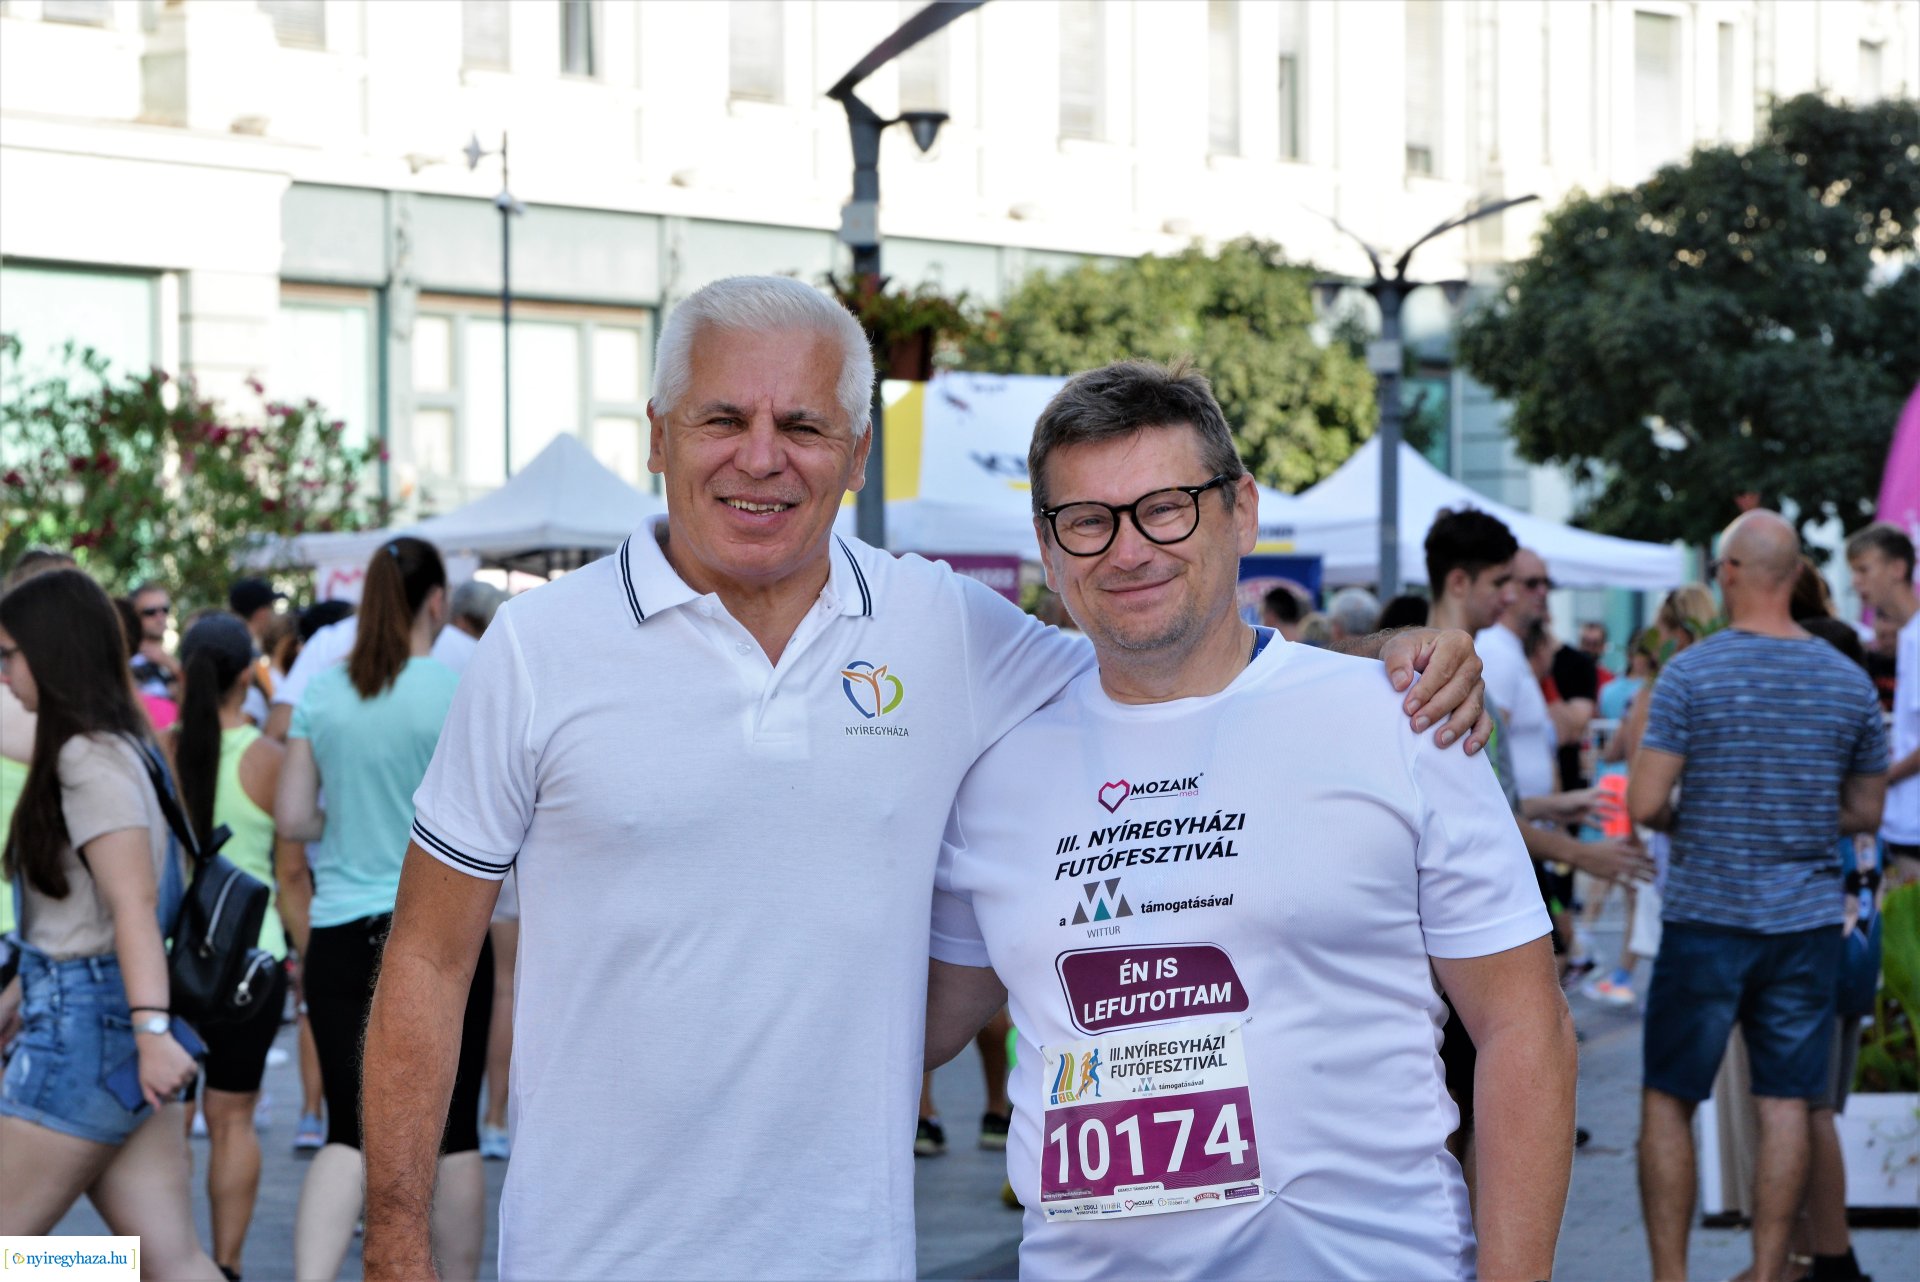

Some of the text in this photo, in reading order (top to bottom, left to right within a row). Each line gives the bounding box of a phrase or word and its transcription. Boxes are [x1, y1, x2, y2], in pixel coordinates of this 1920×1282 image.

[845, 724, 909, 736] NYÍREGYHÁZA
[1130, 776, 1199, 795] MOZAIK
[1179, 789, 1199, 797] med
[1056, 809, 1246, 855] III. NYÍREGYHÁZI
[1055, 835, 1239, 880] FUTÓFESZTIVÁL
[1059, 893, 1234, 926] a támogatásával
[1086, 925, 1121, 938] WITTUR
[1119, 957, 1178, 985] ÉN IS
[1083, 982, 1232, 1024] LEFUTOTTAM
[1110, 1053, 1228, 1079] FUTÓFESZTIVÁL
[1159, 1079, 1204, 1090] támogatásával
[1050, 1103, 1249, 1184] 10174
